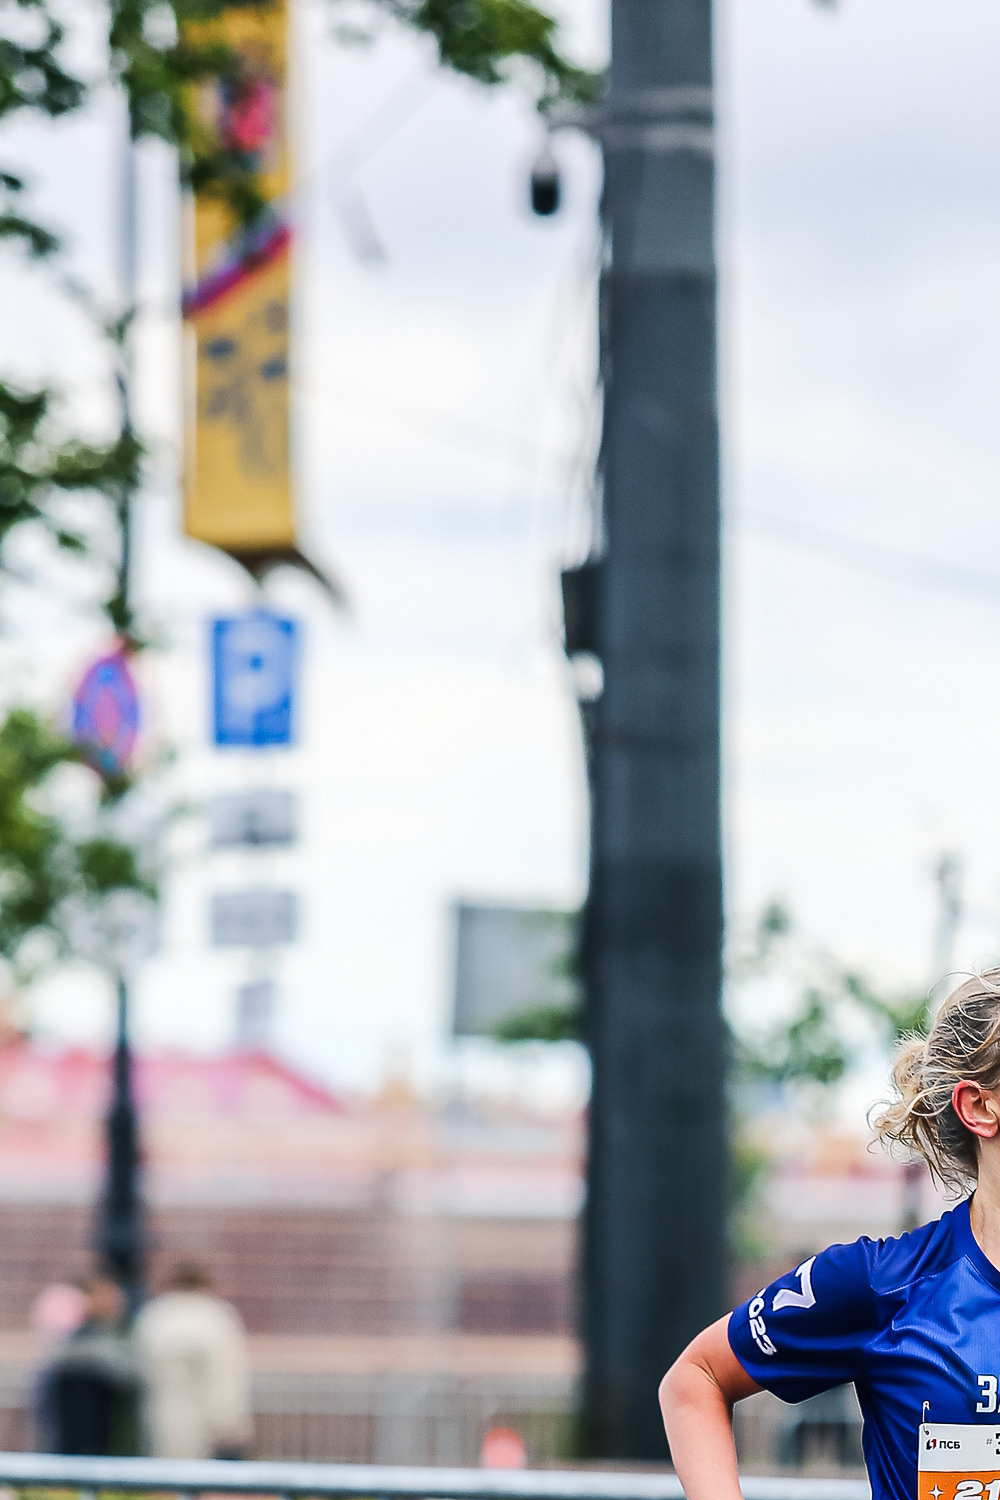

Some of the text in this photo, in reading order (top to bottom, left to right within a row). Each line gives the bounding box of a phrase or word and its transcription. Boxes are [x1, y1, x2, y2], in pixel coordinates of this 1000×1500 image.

[772, 1255, 817, 1312] 7
[748, 1288, 777, 1355] 023
[939, 1440, 961, 1450] ПСБ
